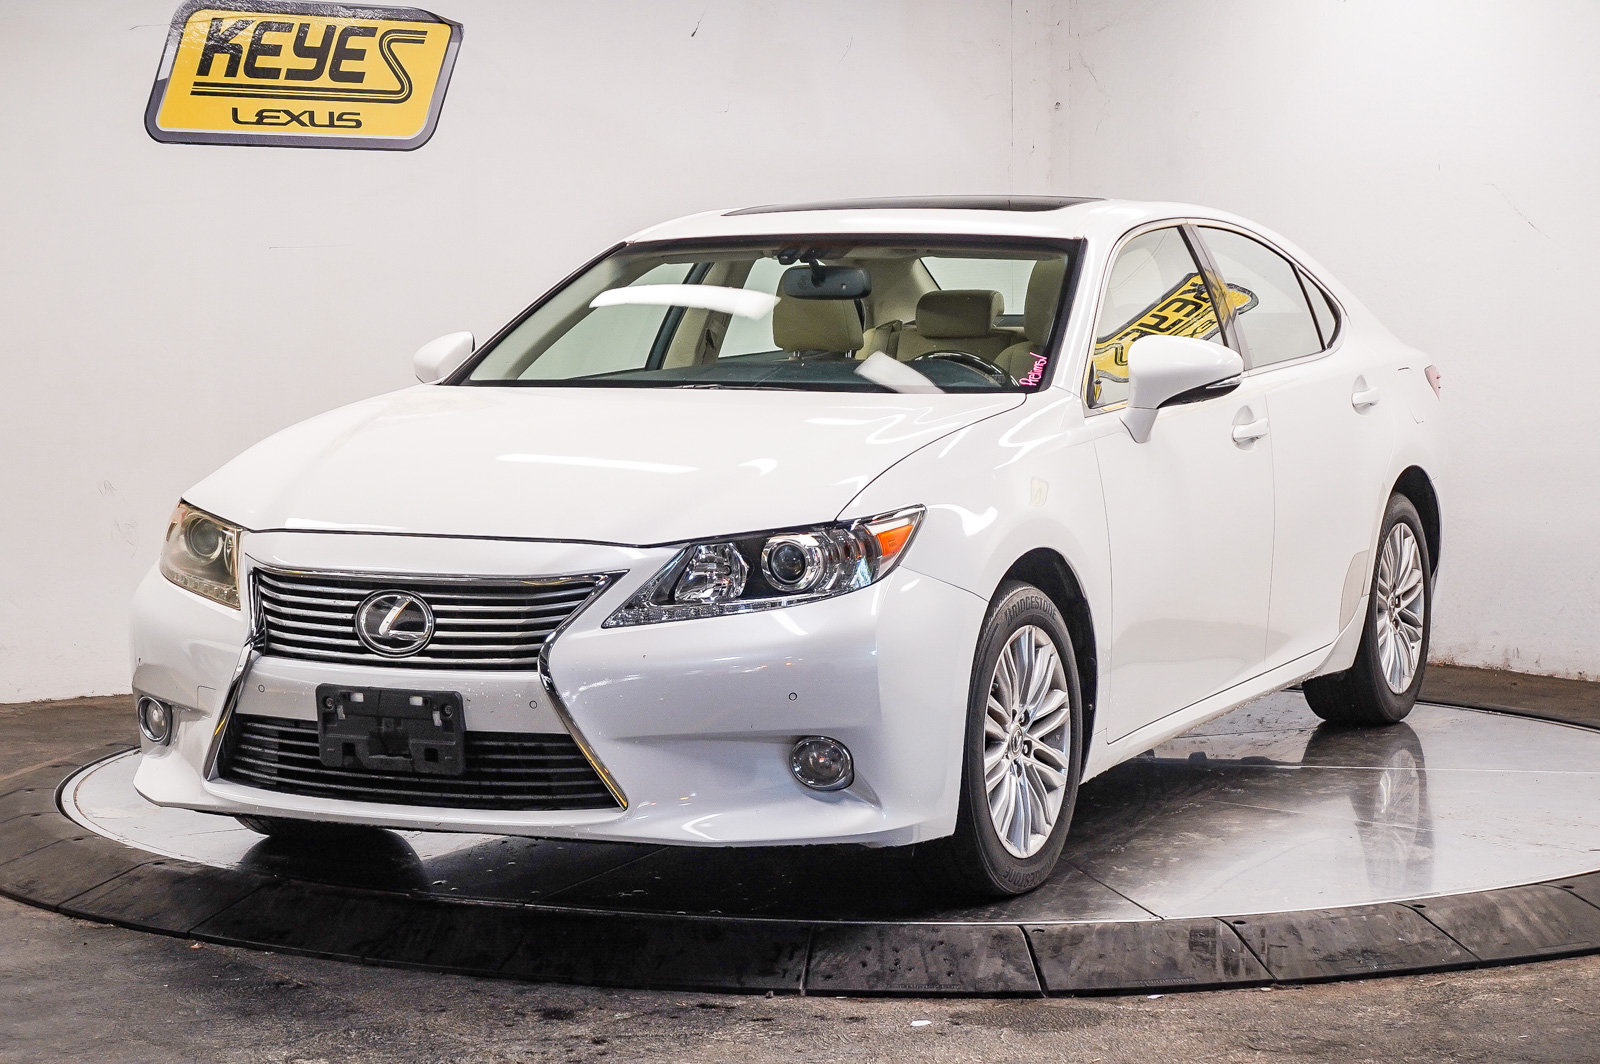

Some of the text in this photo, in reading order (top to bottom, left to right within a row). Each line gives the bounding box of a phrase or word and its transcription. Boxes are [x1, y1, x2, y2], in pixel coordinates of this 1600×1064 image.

[190, 17, 428, 104] KEYES
[231, 107, 363, 129] LEXUS
[1004, 595, 1058, 627] BRIDGESTONE
